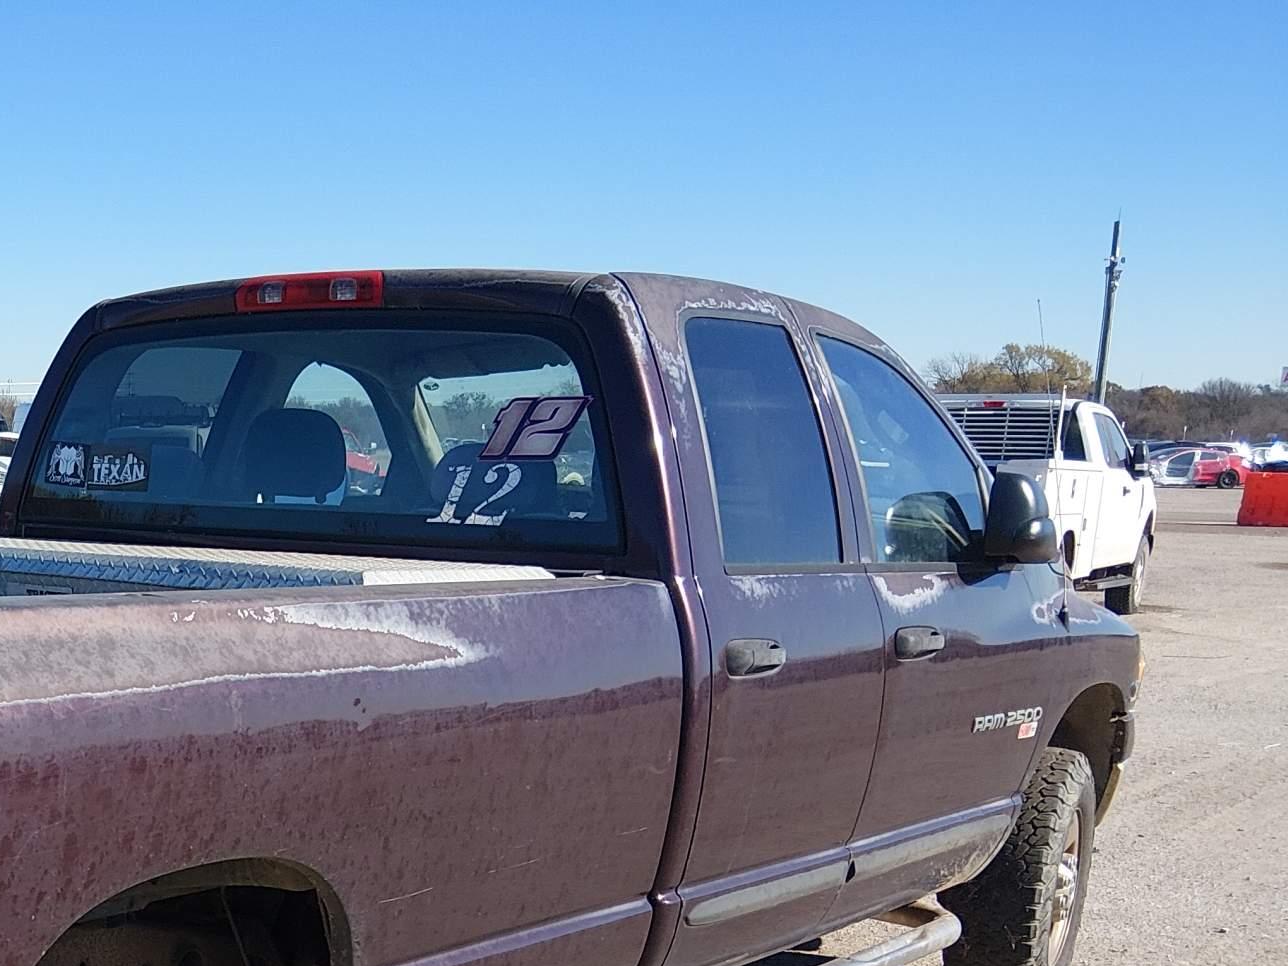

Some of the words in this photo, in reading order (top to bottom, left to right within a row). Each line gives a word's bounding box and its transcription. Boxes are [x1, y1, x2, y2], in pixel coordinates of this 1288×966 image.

[479, 396, 594, 461] 12
[91, 462, 147, 485] TEXAN
[425, 463, 523, 526] 12
[972, 712, 1006, 734] RAM
[1006, 705, 1043, 727] 2500
